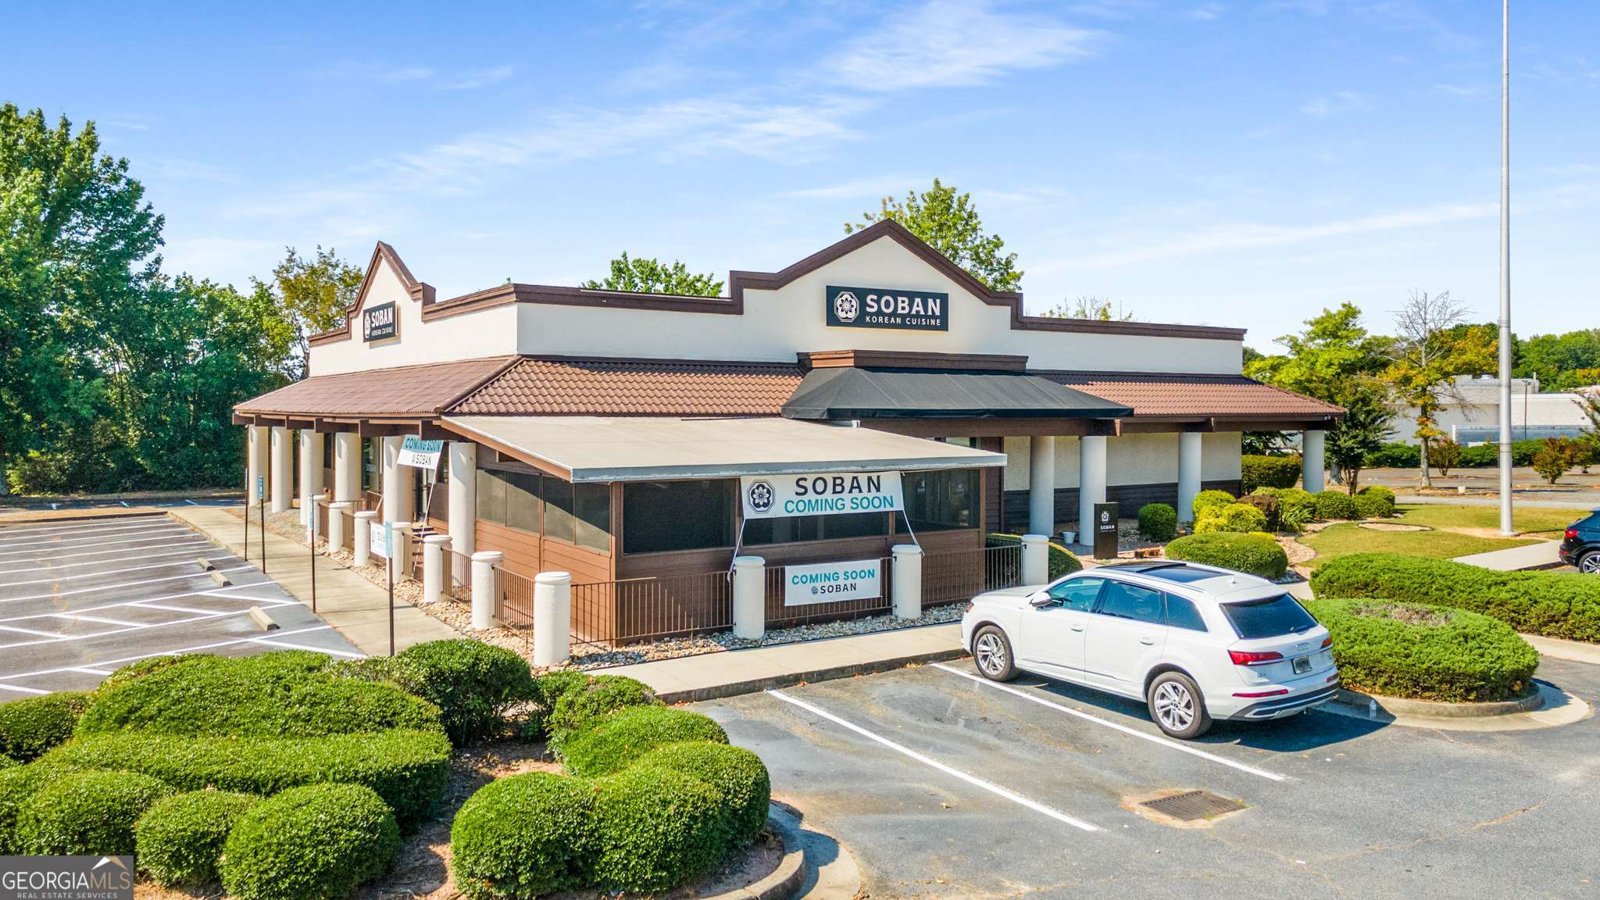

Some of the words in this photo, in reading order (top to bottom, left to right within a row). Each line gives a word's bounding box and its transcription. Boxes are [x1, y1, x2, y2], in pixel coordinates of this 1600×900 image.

[866, 294, 941, 316] SOBAN
[371, 307, 393, 328] SOBAN
[865, 315, 901, 324] KOREAN
[905, 317, 941, 326] CUISINE
[795, 475, 881, 496] SOBAN
[784, 498, 846, 513] COMING
[850, 495, 894, 510] SOON
[791, 571, 840, 585] COMING
[843, 568, 875, 581] SOON
[820, 583, 857, 594] SOBAN
